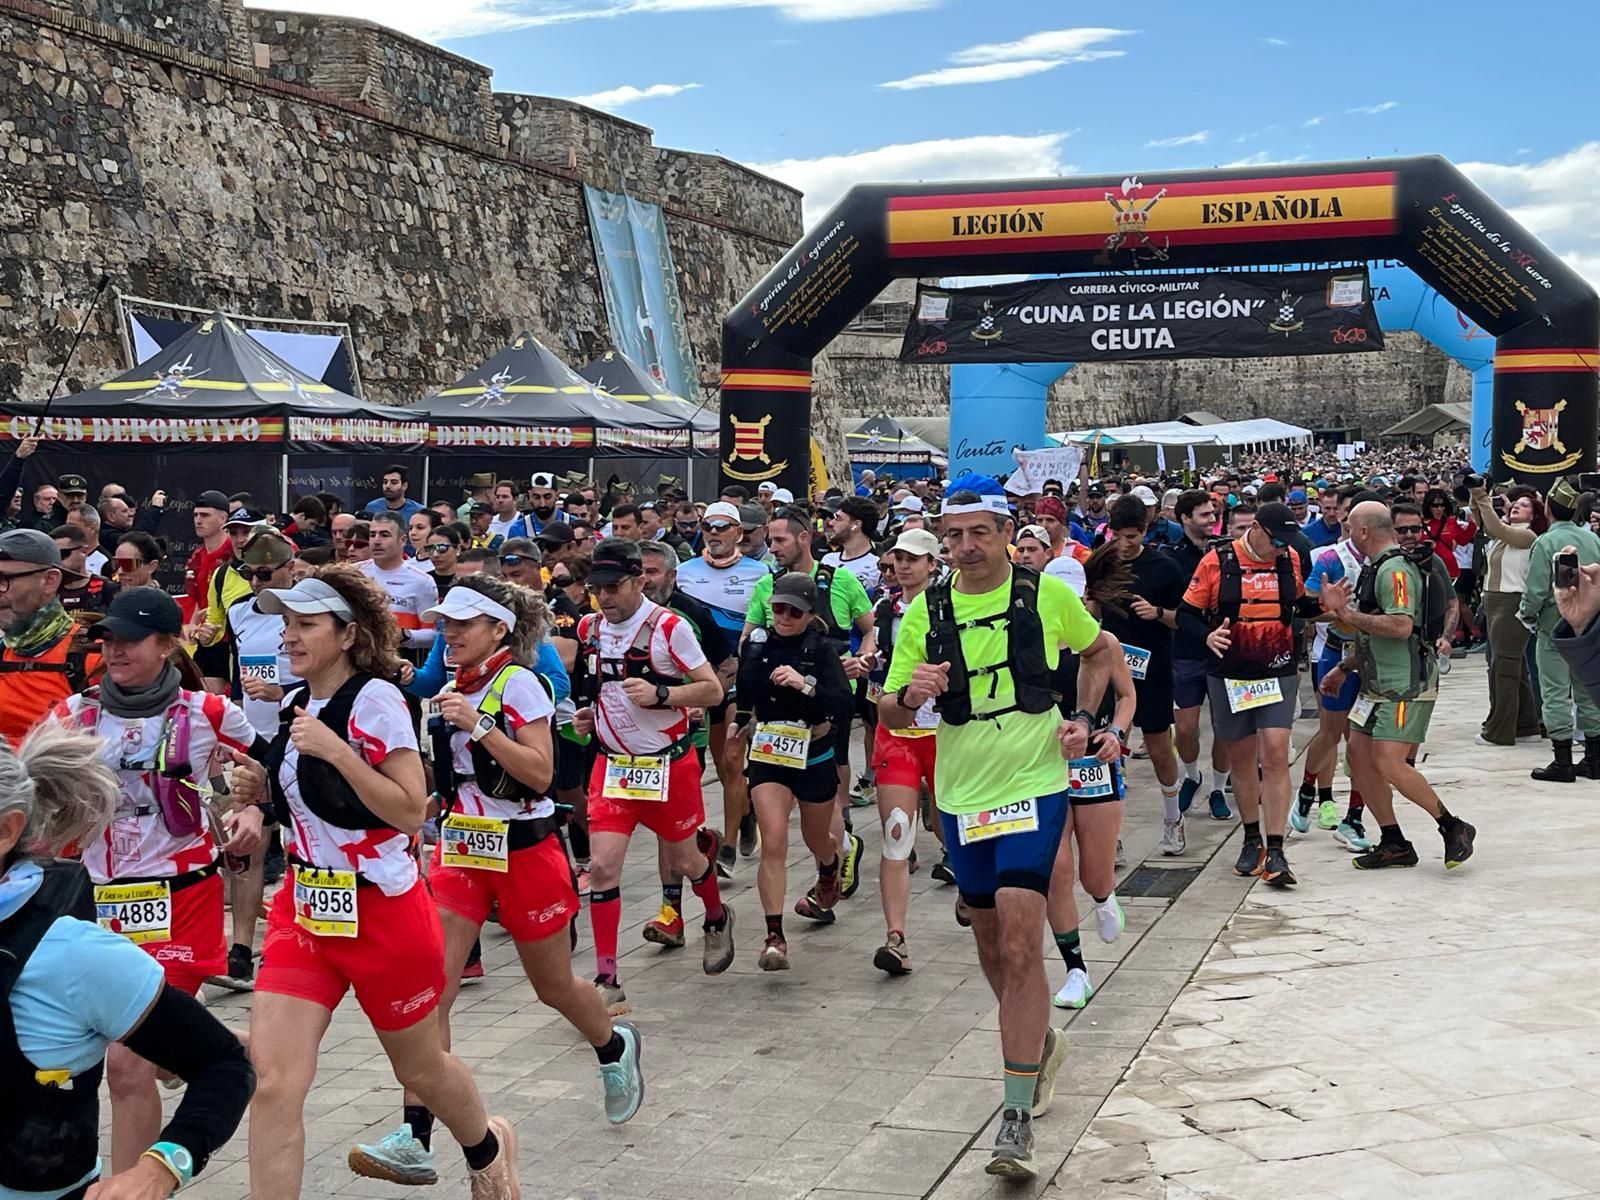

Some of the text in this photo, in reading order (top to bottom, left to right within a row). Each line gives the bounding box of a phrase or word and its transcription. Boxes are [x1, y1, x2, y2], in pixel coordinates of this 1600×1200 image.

[952, 195, 1343, 236] LEGIÓN ESPAÑOLA
[1486, 232, 1501, 244] de
[1497, 240, 1511, 253] la
[1509, 248, 1552, 289] Muerte
[787, 262, 800, 281] del
[1069, 281, 1200, 295] CARRERA CÍVICO-MILITAR
[1092, 304, 1120, 322] DE
[1128, 301, 1156, 321] LA
[1091, 327, 1176, 350] CEUTA
[93, 416, 261, 442] DEPORTIVO
[436, 425, 573, 447] DEPORTIVO
[1250, 680, 1277, 695] 4047
[773, 736, 804, 754] 4571
[626, 769, 661, 785] 4973
[1079, 767, 1103, 783] 680
[467, 832, 504, 852] 4957
[309, 889, 353, 914] 4958
[119, 901, 168, 925] 4883
